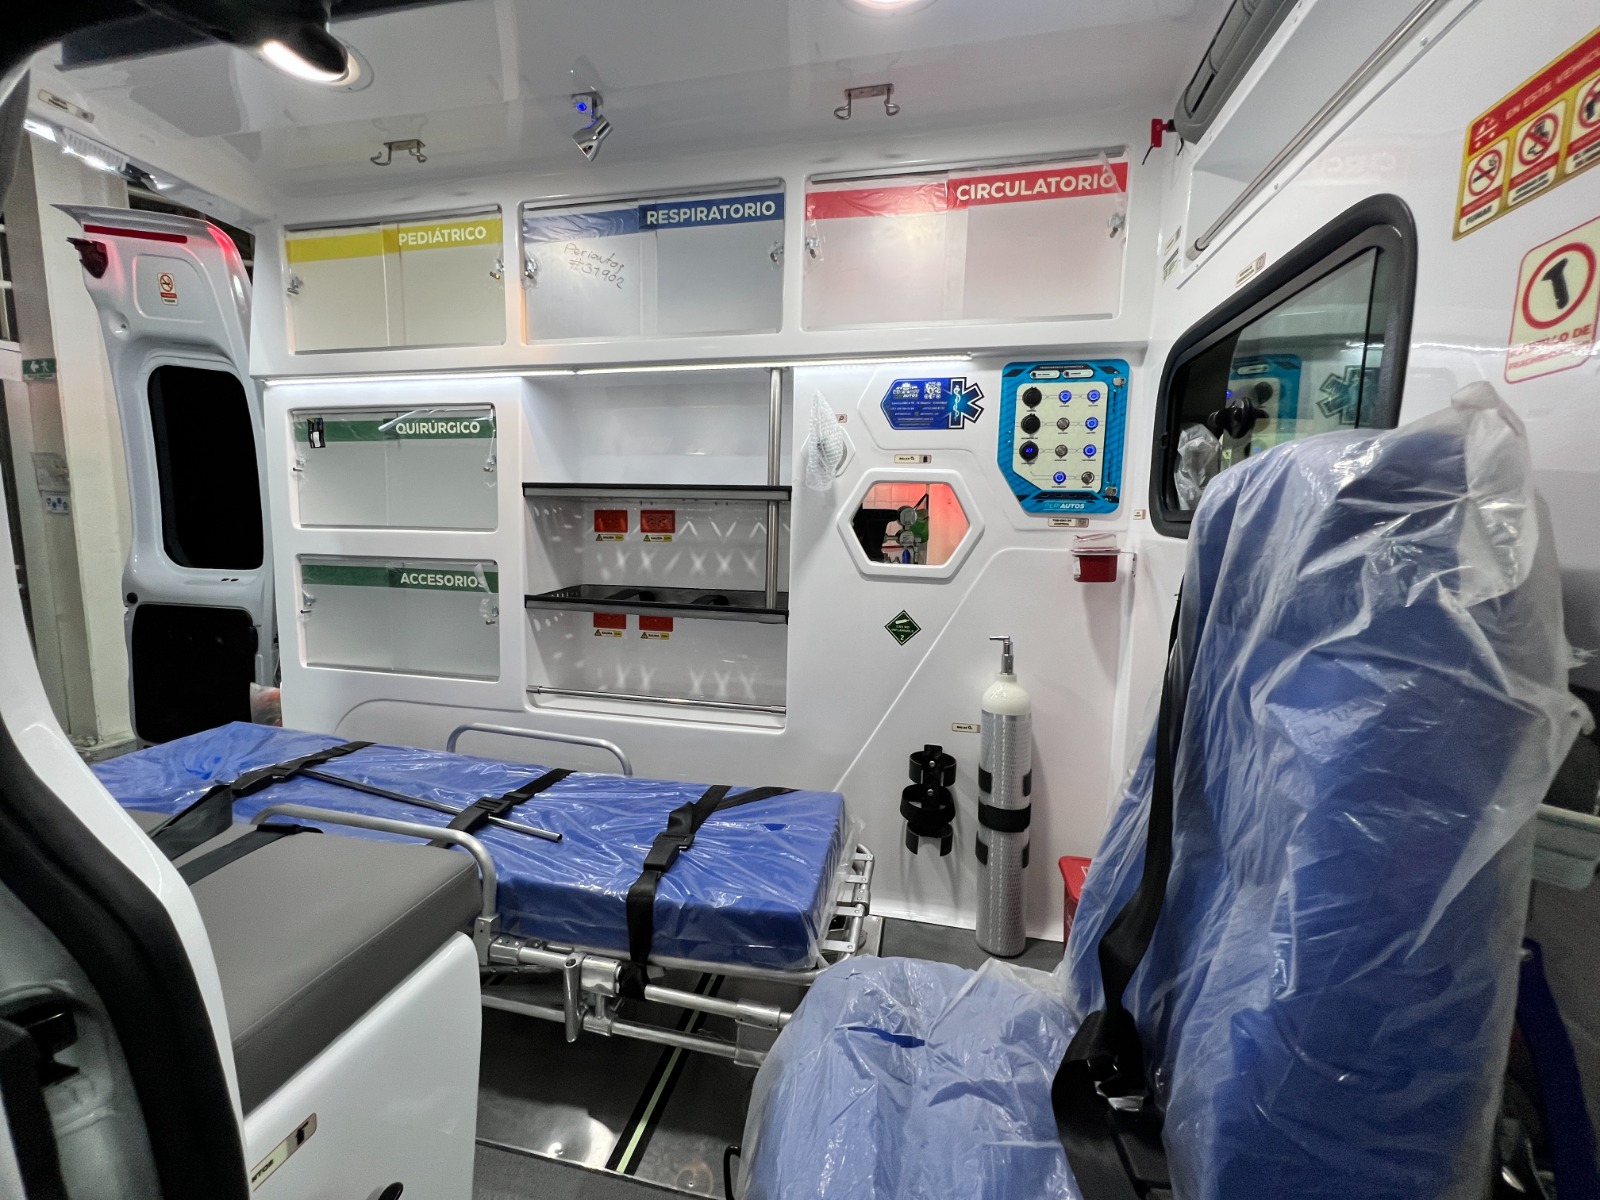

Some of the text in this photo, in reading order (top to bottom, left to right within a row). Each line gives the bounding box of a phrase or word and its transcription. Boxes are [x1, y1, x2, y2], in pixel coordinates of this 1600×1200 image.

[956, 173, 1117, 201] CIRCULATORIO
[646, 201, 776, 225] RESPIRATORIO
[398, 226, 487, 246] PEDIÁTRICO
[395, 420, 481, 435] QUIRÚRGICO
